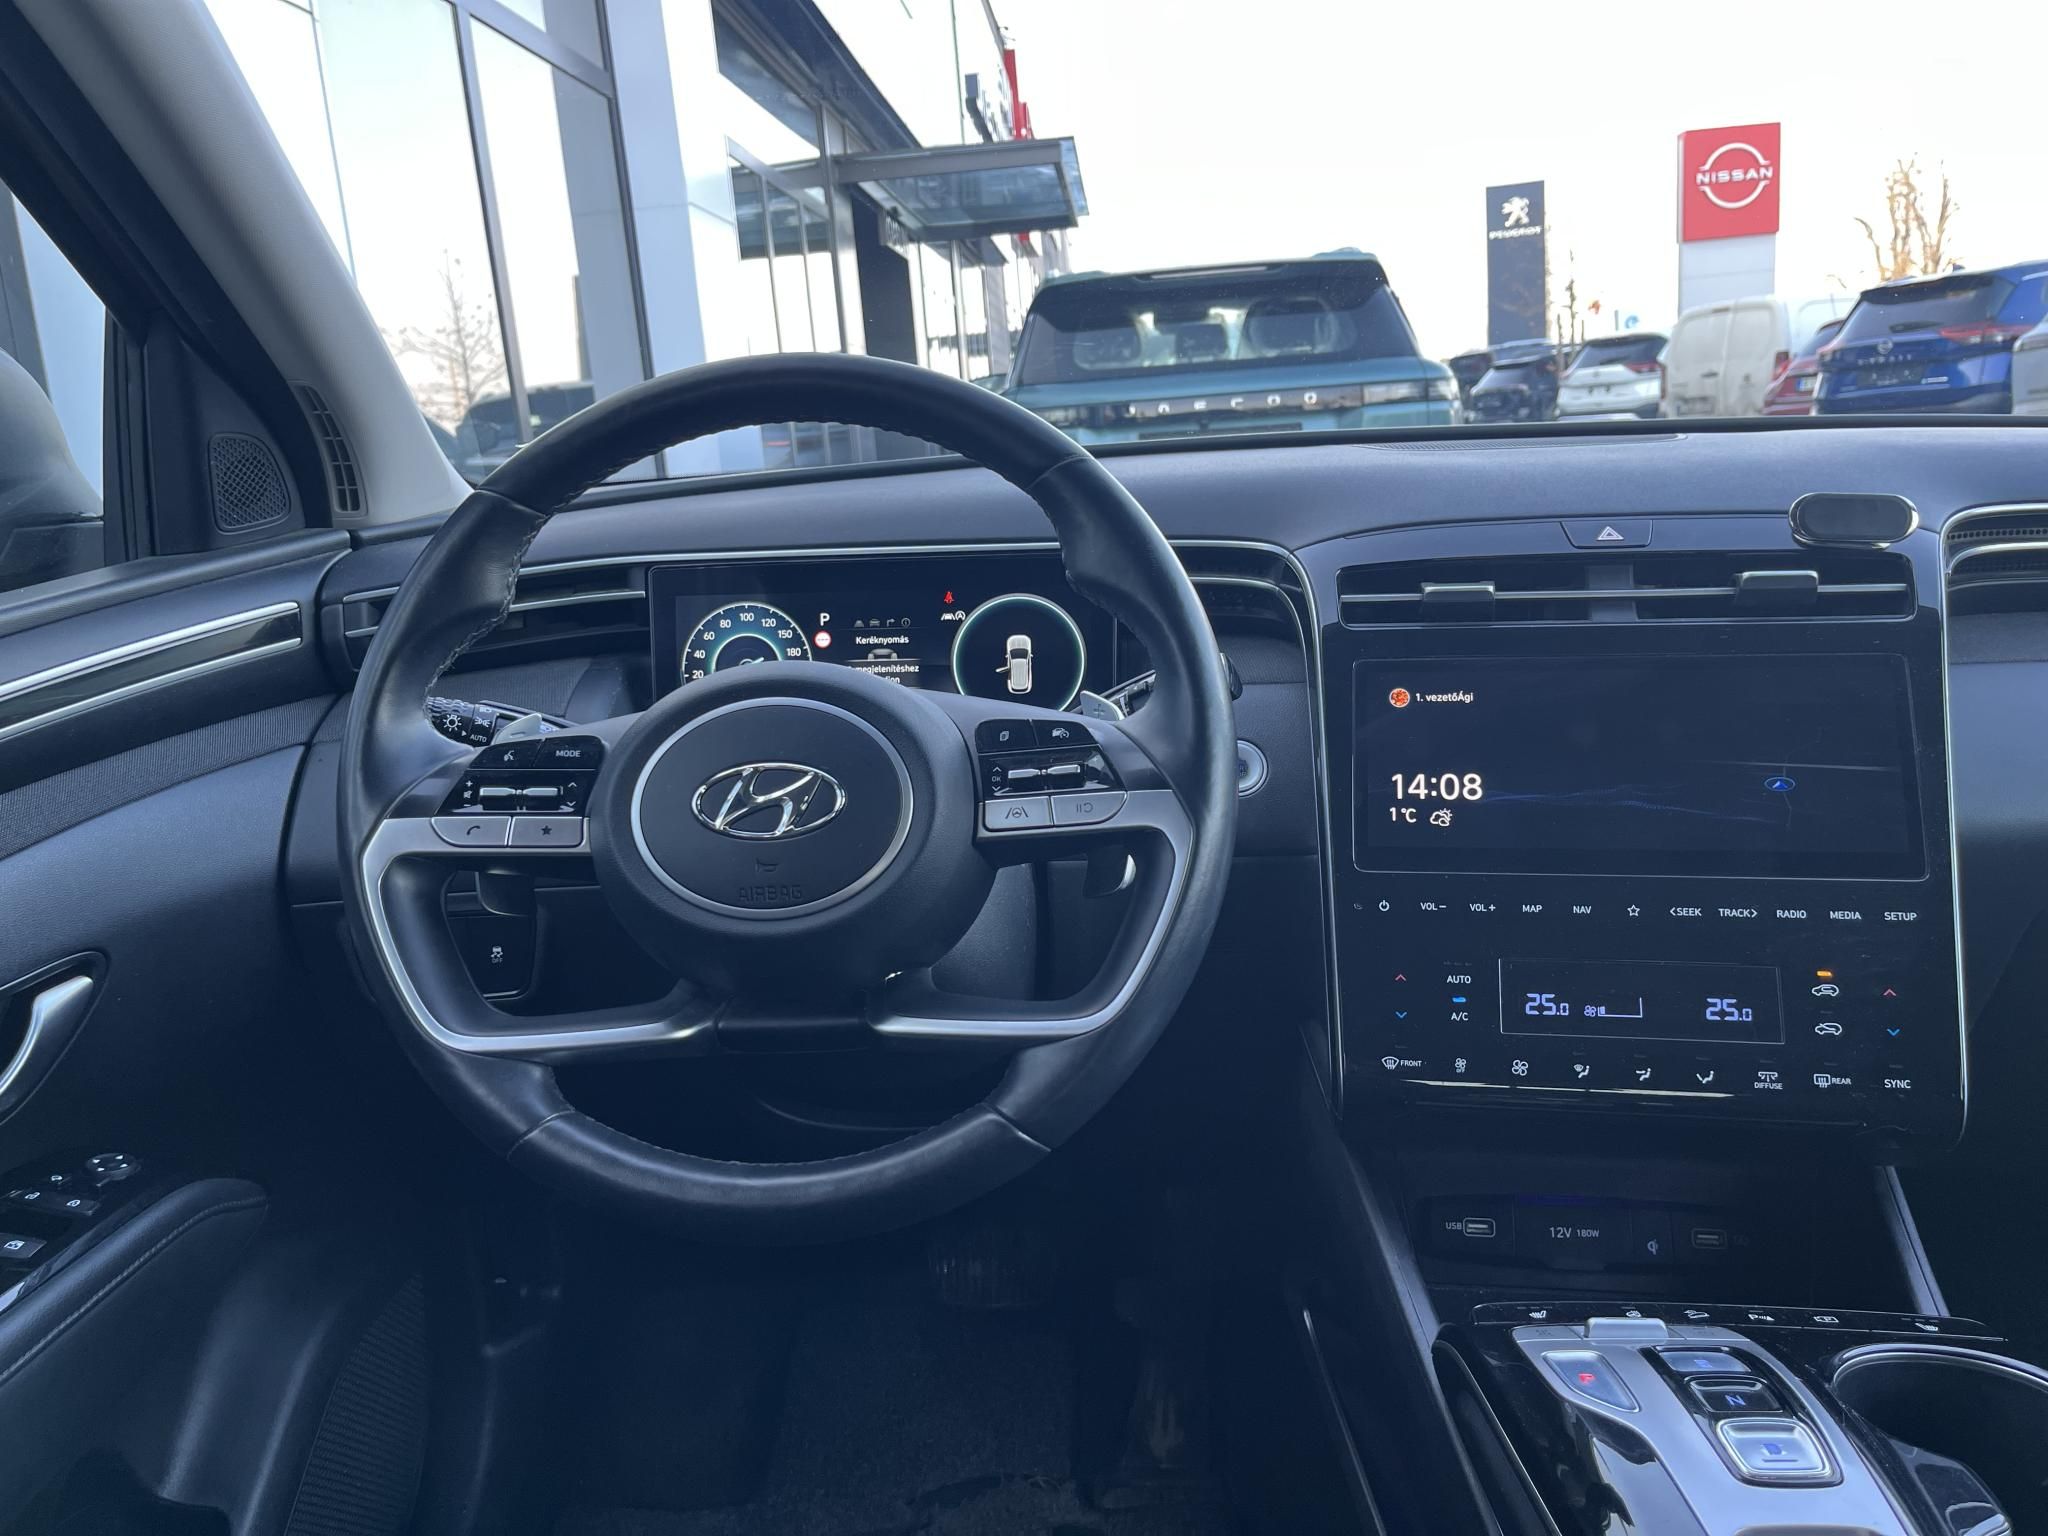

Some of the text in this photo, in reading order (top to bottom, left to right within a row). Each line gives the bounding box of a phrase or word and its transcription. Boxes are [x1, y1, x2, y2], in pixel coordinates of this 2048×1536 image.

[1696, 167, 1773, 186] NISSAN
[739, 613, 755, 622] 100
[761, 618, 777, 627] 120
[820, 612, 830, 626] P
[720, 619, 732, 628] 80
[703, 631, 715, 641] 60
[777, 629, 793, 639] 150
[855, 635, 910, 645] Keréknyomás
[693, 649, 706, 659] 40
[786, 647, 802, 657] 180
[692, 669, 704, 679] 20
[470, 734, 487, 743] AUTO
[556, 750, 581, 758] MODE
[1391, 773, 1483, 801] 14:08
[739, 884, 803, 902] AIRBAG
[1522, 904, 1543, 914] MAP
[1573, 905, 1592, 914] NAV
[1776, 909, 1807, 919] RADIO
[1829, 911, 1861, 920] MEDIA
[1884, 911, 1917, 921] SETUP
[1446, 975, 1472, 984] AUTO
[1525, 993, 1569, 1016] 25.0
[1705, 998, 1752, 1021] 25.0
[1450, 1011, 1469, 1022] A/C
[1400, 1059, 1422, 1068] FRONT
[1754, 1082, 1783, 1090] DIFFUSE
[1831, 1077, 1851, 1086] REAR
[1884, 1078, 1911, 1089] SYNC
[1445, 1222, 1462, 1230] USB
[1549, 1227, 1600, 1239] 12V 180W
[1724, 1393, 1747, 1408] N
